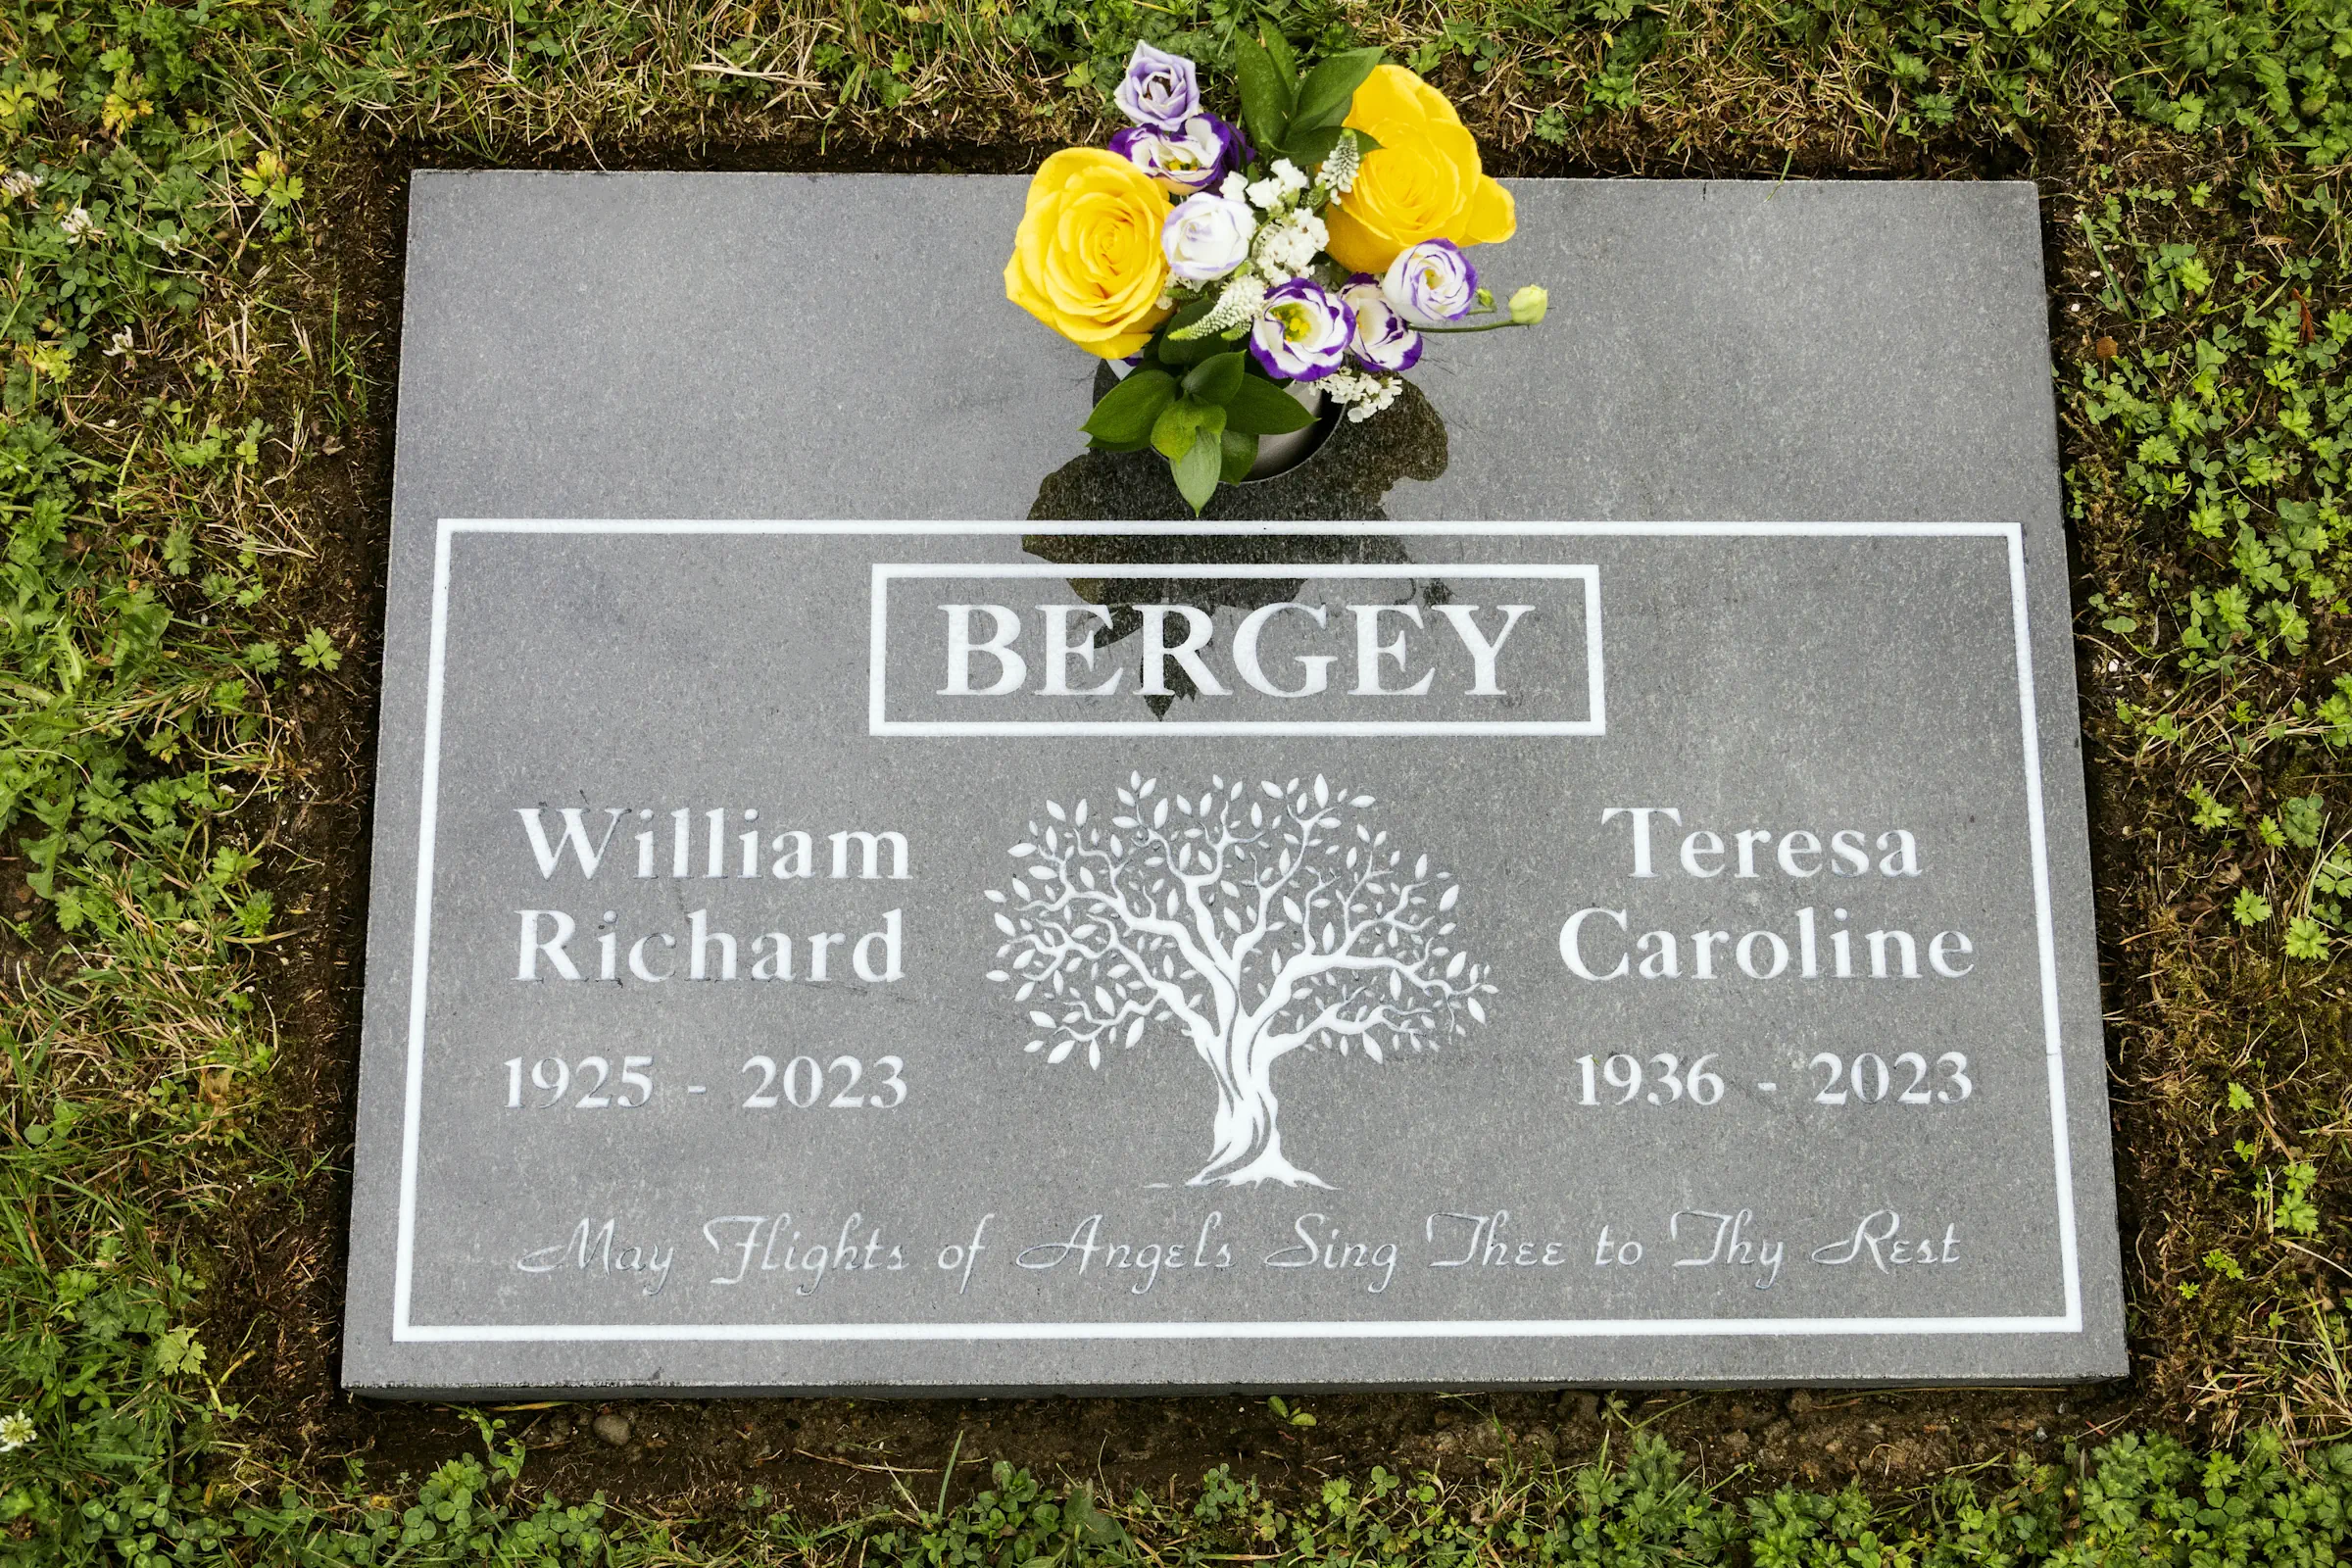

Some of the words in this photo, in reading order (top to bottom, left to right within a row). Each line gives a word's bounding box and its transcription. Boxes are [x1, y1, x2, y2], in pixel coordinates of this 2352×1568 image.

[937, 602, 1537, 700] BERGEY
[515, 806, 913, 880] William
[1600, 806, 1923, 879] Teresa
[514, 907, 906, 984] Richard
[1558, 906, 1976, 982] Caroline
[504, 1054, 655, 1109] 1925
[742, 1054, 908, 1110] 2023
[1575, 1052, 1727, 1107] 1936
[1808, 1051, 1974, 1106] 2023
[515, 1215, 676, 1298] May
[703, 1211, 907, 1297] Flights
[937, 1212, 996, 1296] of
[1015, 1210, 1232, 1297] Angels
[1263, 1211, 1399, 1295] Sing
[1425, 1208, 1565, 1268] Thee
[1595, 1224, 1644, 1267] to
[1670, 1207, 1786, 1291] Thy
[1811, 1207, 1962, 1275] Rest
